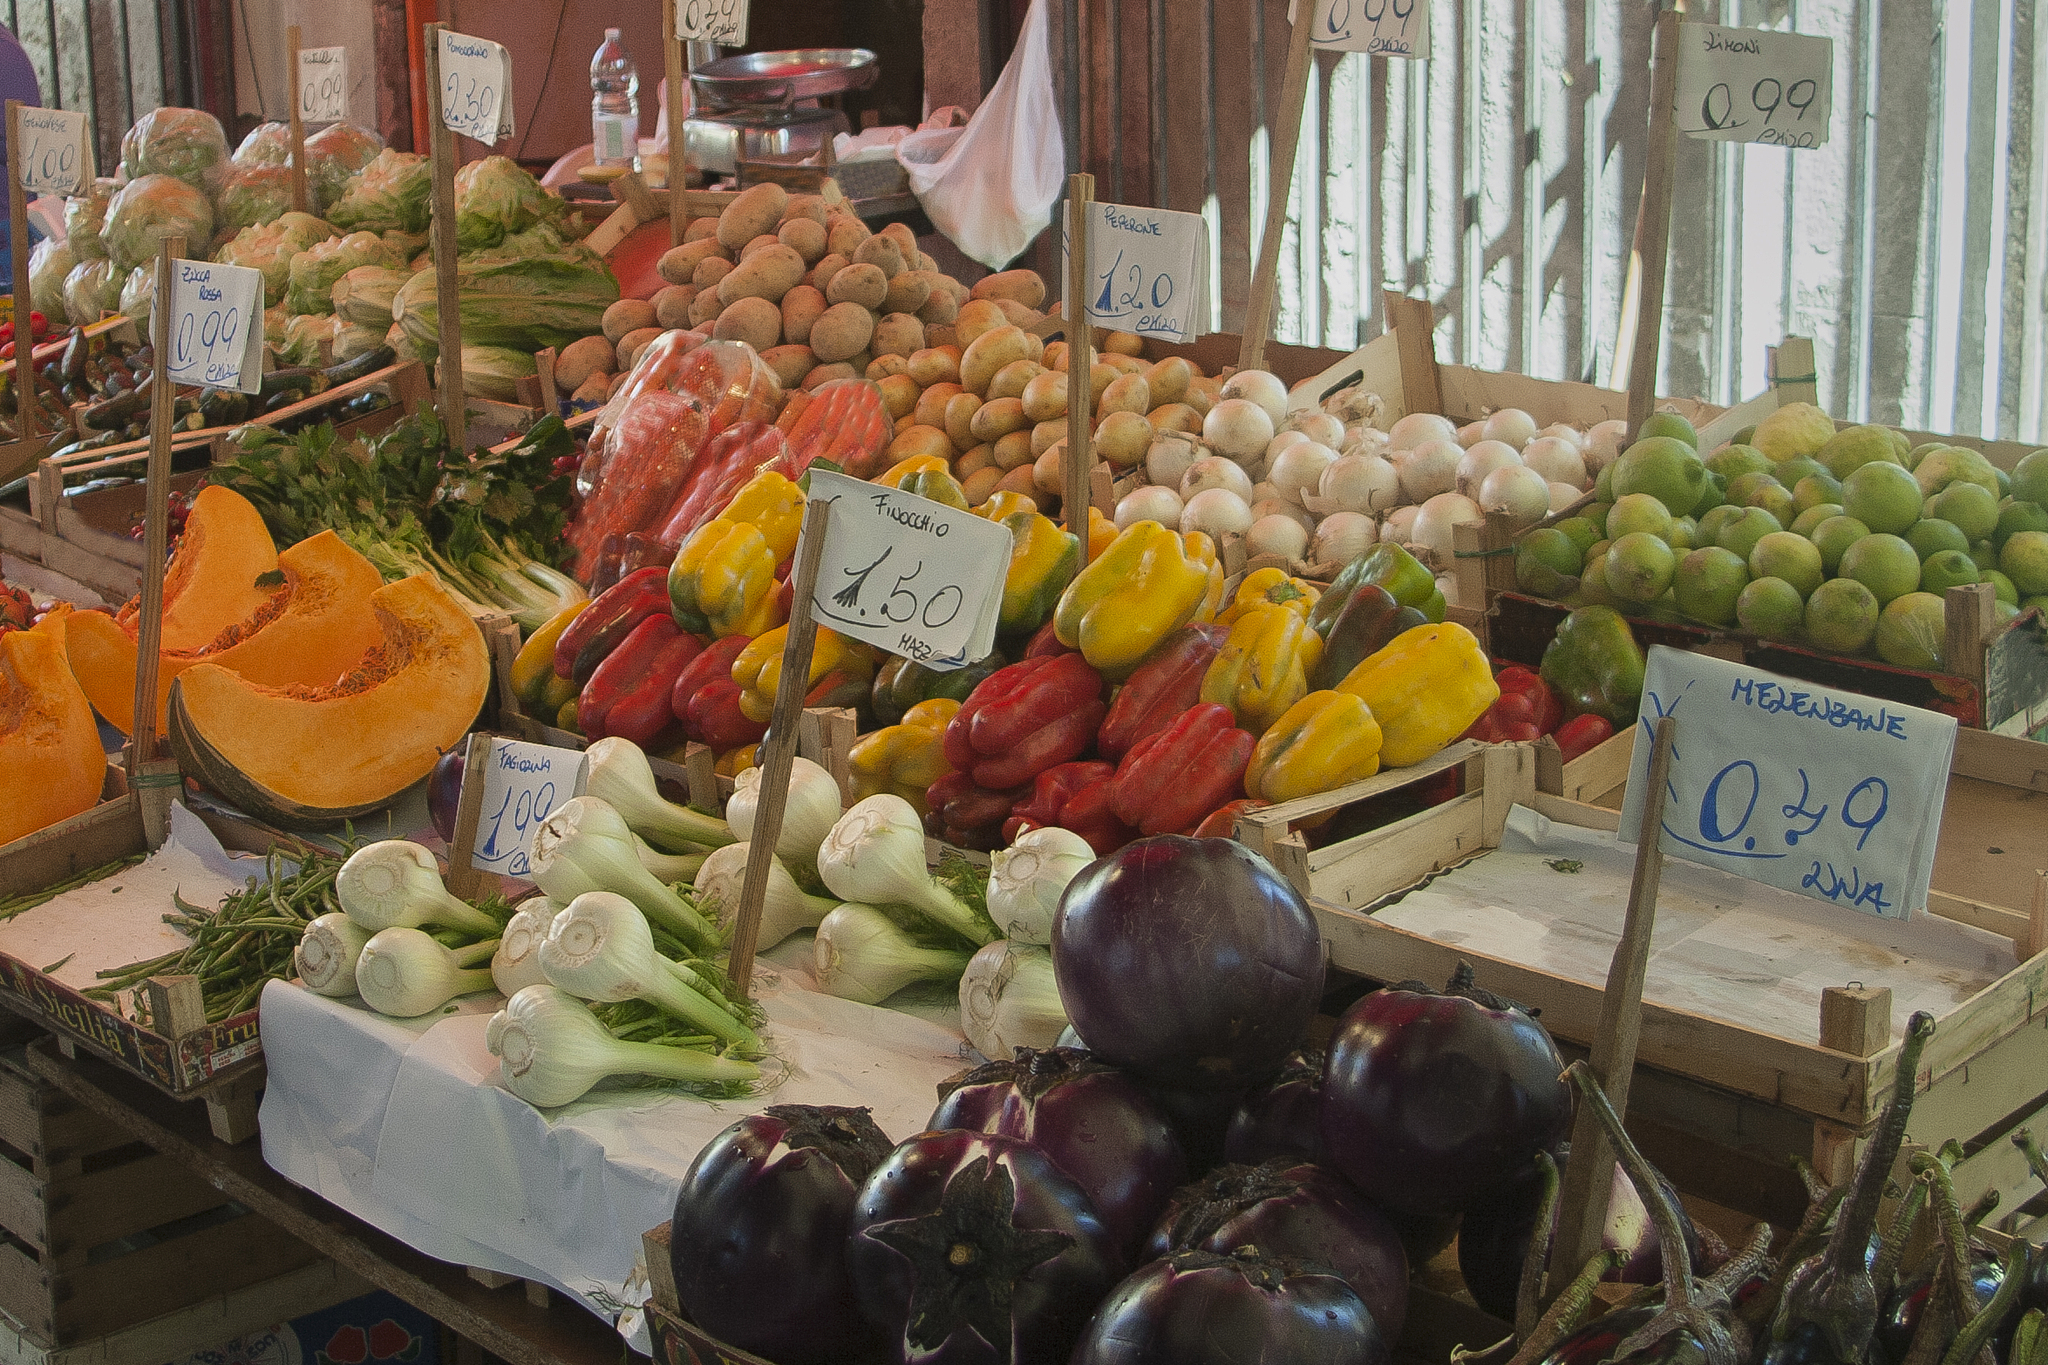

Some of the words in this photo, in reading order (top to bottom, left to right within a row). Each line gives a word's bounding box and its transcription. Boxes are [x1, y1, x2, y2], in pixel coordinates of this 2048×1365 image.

[444, 72, 493, 124] 2.50
[1701, 78, 1816, 130] 0.99
[26, 138, 75, 187] 1.00
[1104, 205, 1162, 236] PEPERONE
[1095, 249, 1173, 313] 1.20
[178, 307, 237, 363] 0.99
[832, 545, 963, 629] 1.50
[32, 975, 126, 1058] Sicilia
